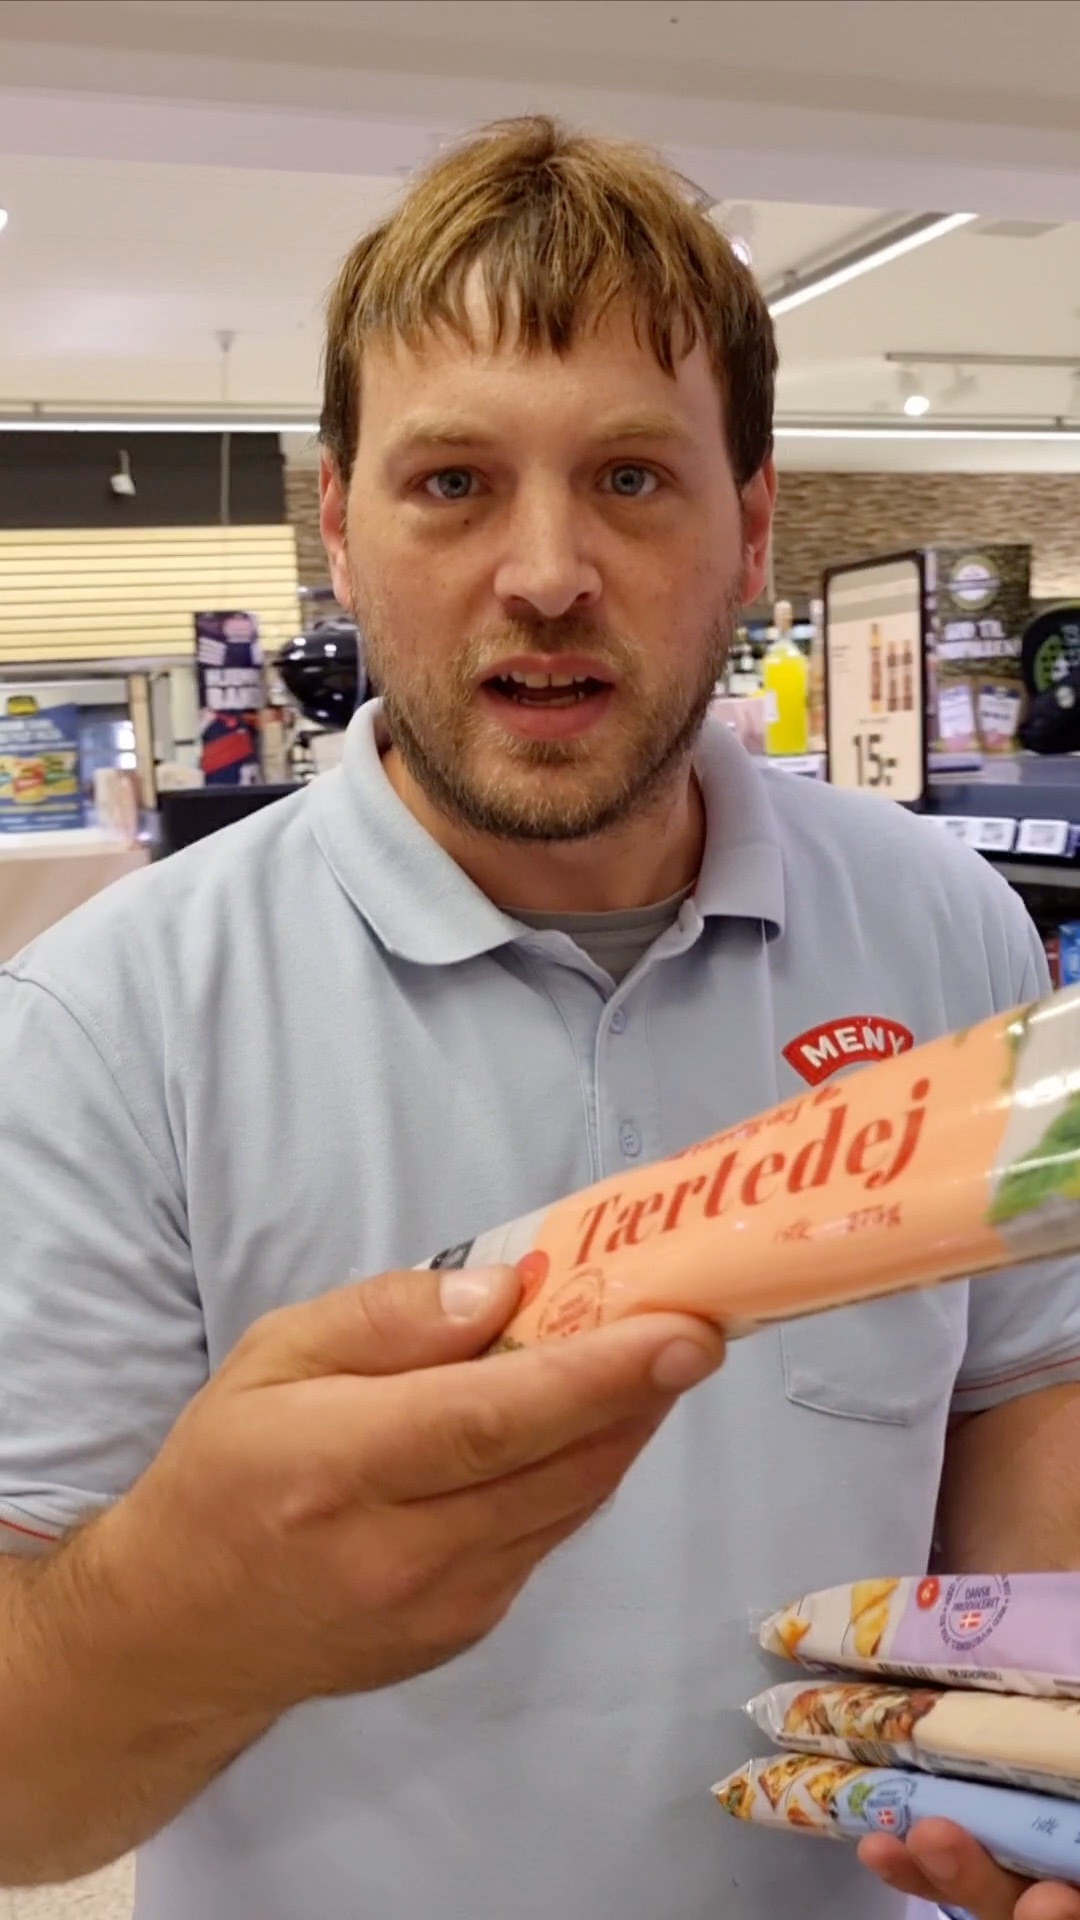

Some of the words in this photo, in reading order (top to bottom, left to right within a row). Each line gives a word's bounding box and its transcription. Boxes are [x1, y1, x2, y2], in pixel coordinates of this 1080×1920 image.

[800, 1025, 905, 1068] MENY
[574, 1078, 930, 1265] Tærtedej
[965, 1585, 991, 1600] DANSK
